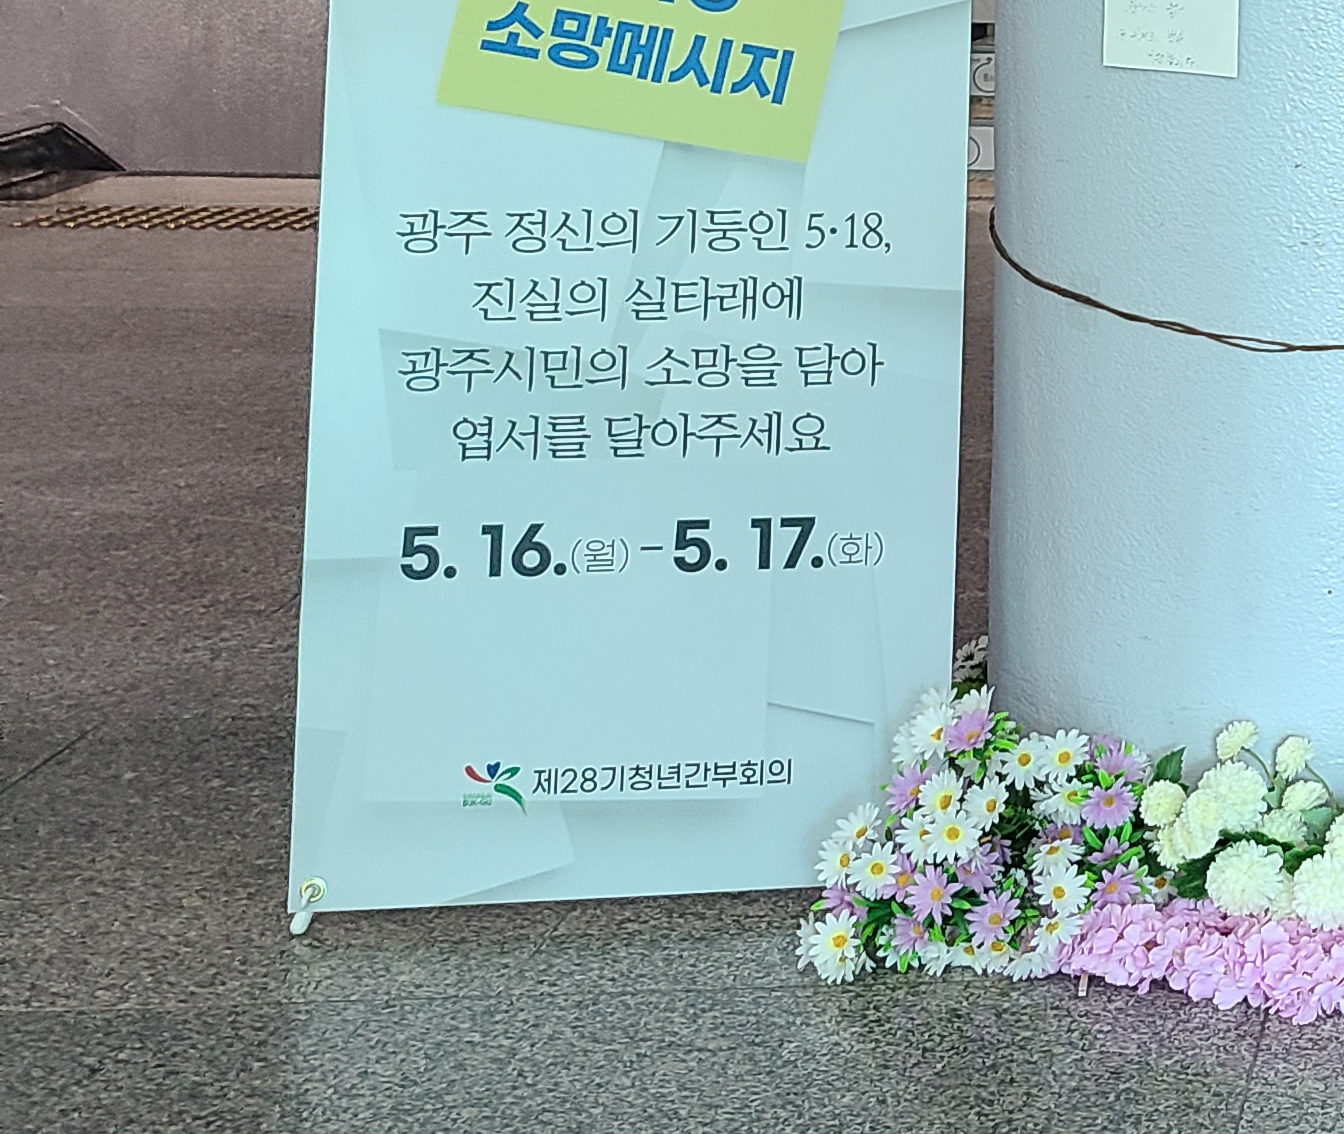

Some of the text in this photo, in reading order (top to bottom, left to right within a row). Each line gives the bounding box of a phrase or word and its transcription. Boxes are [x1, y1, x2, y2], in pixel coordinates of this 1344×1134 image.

[479, 0, 796, 106] 소망메시지
[395, 208, 893, 255] 광주 정신의 기둥인 5·18,
[471, 275, 803, 322] 진실의 실타래에
[398, 341, 885, 393] 광주시민의 소망을 담아
[451, 411, 831, 461] 엽서를 달아주세요
[399, 525, 457, 581] 5.
[531, 758, 794, 795] 제28기청년간부회의
